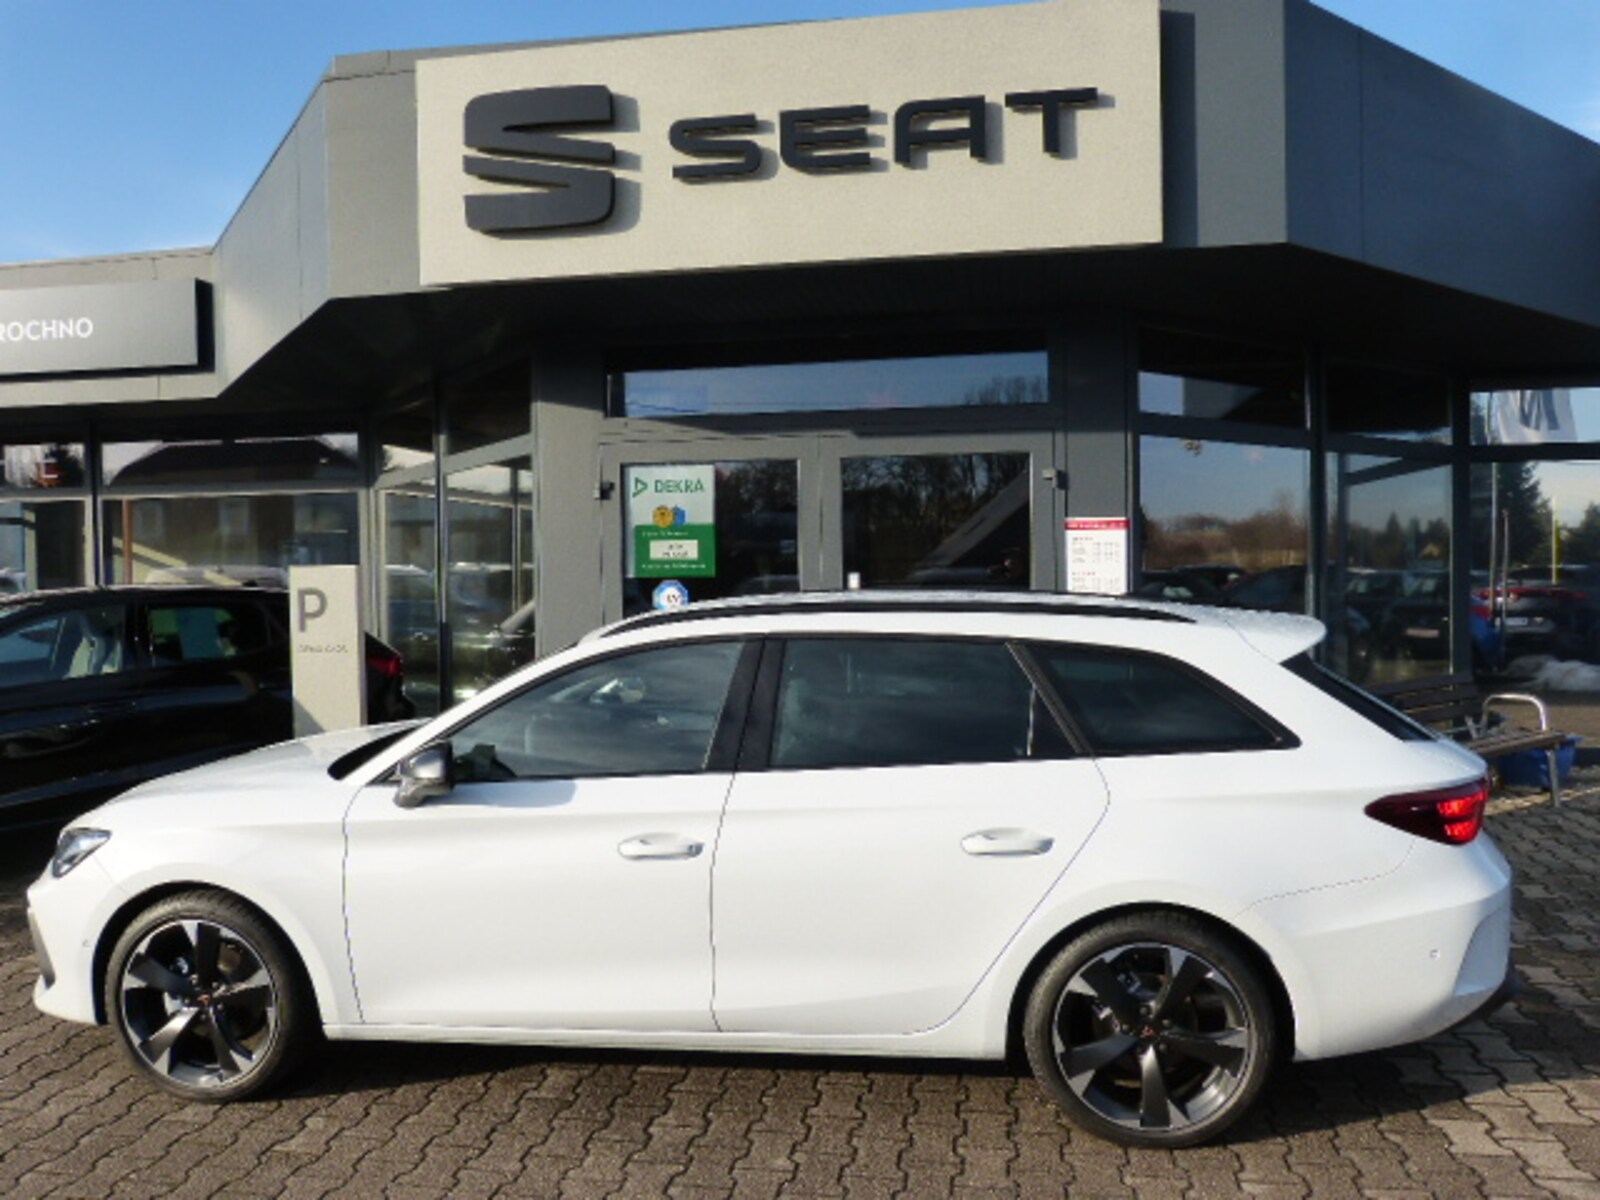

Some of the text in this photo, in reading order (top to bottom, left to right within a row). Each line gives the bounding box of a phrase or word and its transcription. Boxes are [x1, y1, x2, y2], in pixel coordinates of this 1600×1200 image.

[668, 87, 1098, 182] SEAT
[654, 479, 705, 494] DEKRA
[297, 587, 328, 633] P
